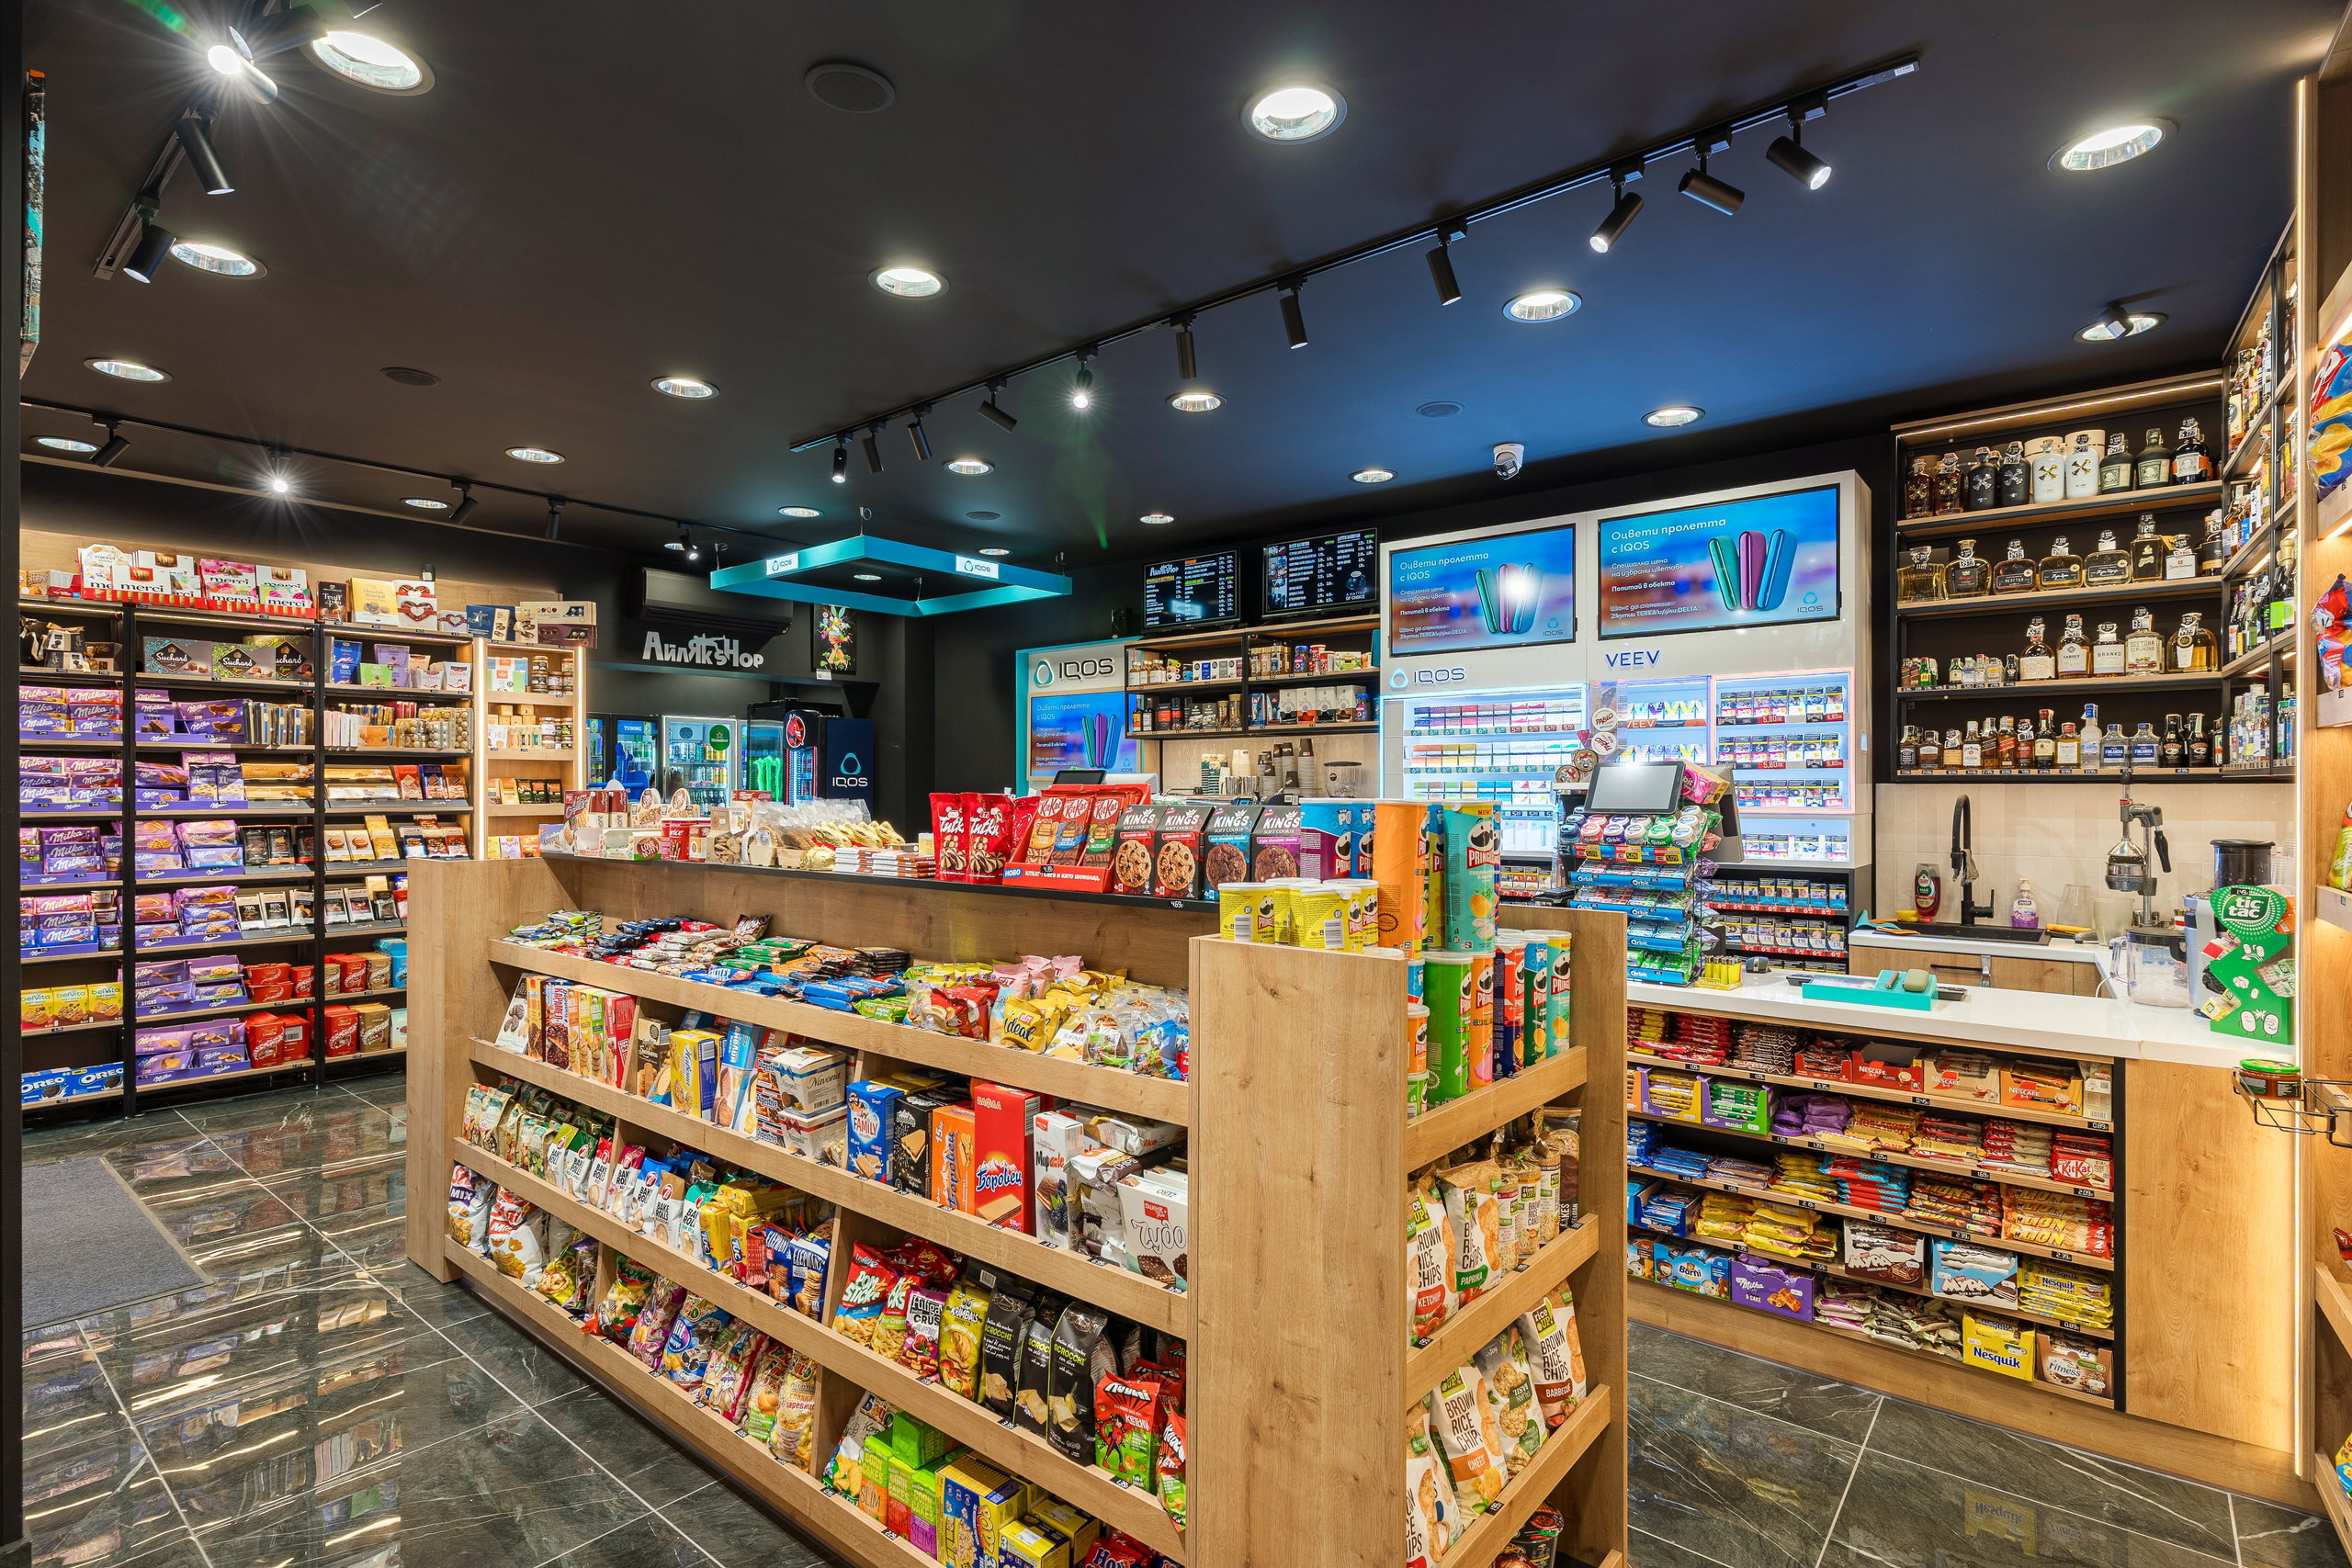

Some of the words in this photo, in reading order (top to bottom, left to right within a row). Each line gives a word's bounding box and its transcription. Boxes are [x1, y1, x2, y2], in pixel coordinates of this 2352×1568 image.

[1611, 529, 1658, 540] Оцвети
[1661, 519, 1726, 536] пролетта
[1621, 540, 1650, 552] IQOS
[779, 558, 792, 568] IQOS
[1400, 560, 1436, 570] Оцвети
[1439, 553, 1488, 567] пролетта
[1611, 560, 1649, 570] Специална
[974, 564, 991, 573] IQOS
[1622, 569, 1650, 578] избрани
[1652, 563, 1684, 573] цветове
[210, 577, 249, 585] merci
[1408, 570, 1430, 581] IQOS
[121, 583, 164, 592] merci
[1611, 583, 1642, 592] Попитай
[212, 594, 252, 604] merci
[268, 598, 305, 607] merci
[1400, 607, 1424, 615] Попитай
[1797, 605, 1823, 614] IQOS
[156, 653, 187, 662] Suchard
[222, 658, 253, 666] Suchard
[1606, 650, 1660, 669] VEEV
[1059, 658, 1114, 680] IQOS
[1413, 667, 1465, 684] IQOS
[74, 692, 106, 702] Milka
[74, 706, 107, 716] Milka
[24, 719, 53, 728] Milka
[81, 720, 110, 729] Milka
[71, 760, 104, 771] Milka
[832, 776, 868, 788] IQOS
[75, 789, 108, 798] Milka
[1038, 797, 1062, 818] KitKat
[1063, 798, 1089, 819] KitKat
[1093, 798, 1119, 820] KitKat
[939, 815, 964, 834] Tutk
[1123, 814, 1155, 826] KINGS
[1165, 815, 1199, 826] KINGS
[1214, 815, 1250, 828] KINGS
[1263, 817, 1300, 829] KINGS
[969, 818, 1000, 836] Tutku
[50, 830, 84, 843] Milka
[50, 844, 85, 857] Milka
[640, 842, 654, 852] LOVE
[641, 846, 659, 859] NUTTY
[53, 858, 88, 871] Milka
[1004, 868, 1021, 878] НОВО
[40, 898, 75, 911] Milka
[2235, 897, 2260, 909] tic
[2228, 906, 2260, 918] tac
[47, 929, 82, 942] Milka
[56, 990, 85, 998] belVita
[92, 987, 120, 995] belVita
[1019, 1012, 1034, 1024] ELIT
[80, 1069, 123, 1085] OREO
[807, 1072, 841, 1089] Navona
[21, 1077, 65, 1093] OREO
[757, 1094, 778, 1108] Digestive
[977, 1097, 1001, 1110] ВАФЛА
[854, 1117, 879, 1136] FAMILY
[786, 1133, 806, 1145] Navona
[596, 1164, 608, 1174] BAKE
[1114, 1157, 1138, 1170] CHIPS
[2061, 1162, 2093, 1179] KitKat
[976, 1166, 1023, 1192] Боровец
[451, 1189, 474, 1201] MIX
[657, 1202, 670, 1213] BAKE
[656, 1210, 669, 1219] ROLLS
[2025, 1215, 2067, 1230] LION
[701, 1230, 710, 1254] TUC
[2023, 1229, 2065, 1245] LION
[731, 1238, 742, 1262] TUC
[855, 1254, 878, 1269] Lorenz
[1679, 1265, 1702, 1278] Barni
[855, 1270, 880, 1287] POM
[1460, 1273, 1483, 1285] PAPRIKA
[2042, 1277, 2075, 1290] Nesquik
[842, 1286, 880, 1303] STICKS
[1418, 1291, 1442, 1308] KETCHUP
[951, 1306, 978, 1323] KRAMBALS
[1533, 1310, 1548, 1323] rice
[985, 1325, 1012, 1341] SCROCCHI
[1540, 1328, 1566, 1355] BROWN
[1054, 1343, 1087, 1367] SCROCCHI
[1543, 1351, 1562, 1368] RICE
[1973, 1347, 2021, 1369] Nesquik
[1544, 1362, 1569, 1382] CHIPS
[1546, 1383, 1571, 1398] BARBECUE
[1444, 1390, 1476, 1419] BROWN
[1451, 1413, 1473, 1435] RICE
[864, 1450, 880, 1465] CORN
[862, 1461, 884, 1484] CAKES
[860, 1490, 881, 1509] SLIM
